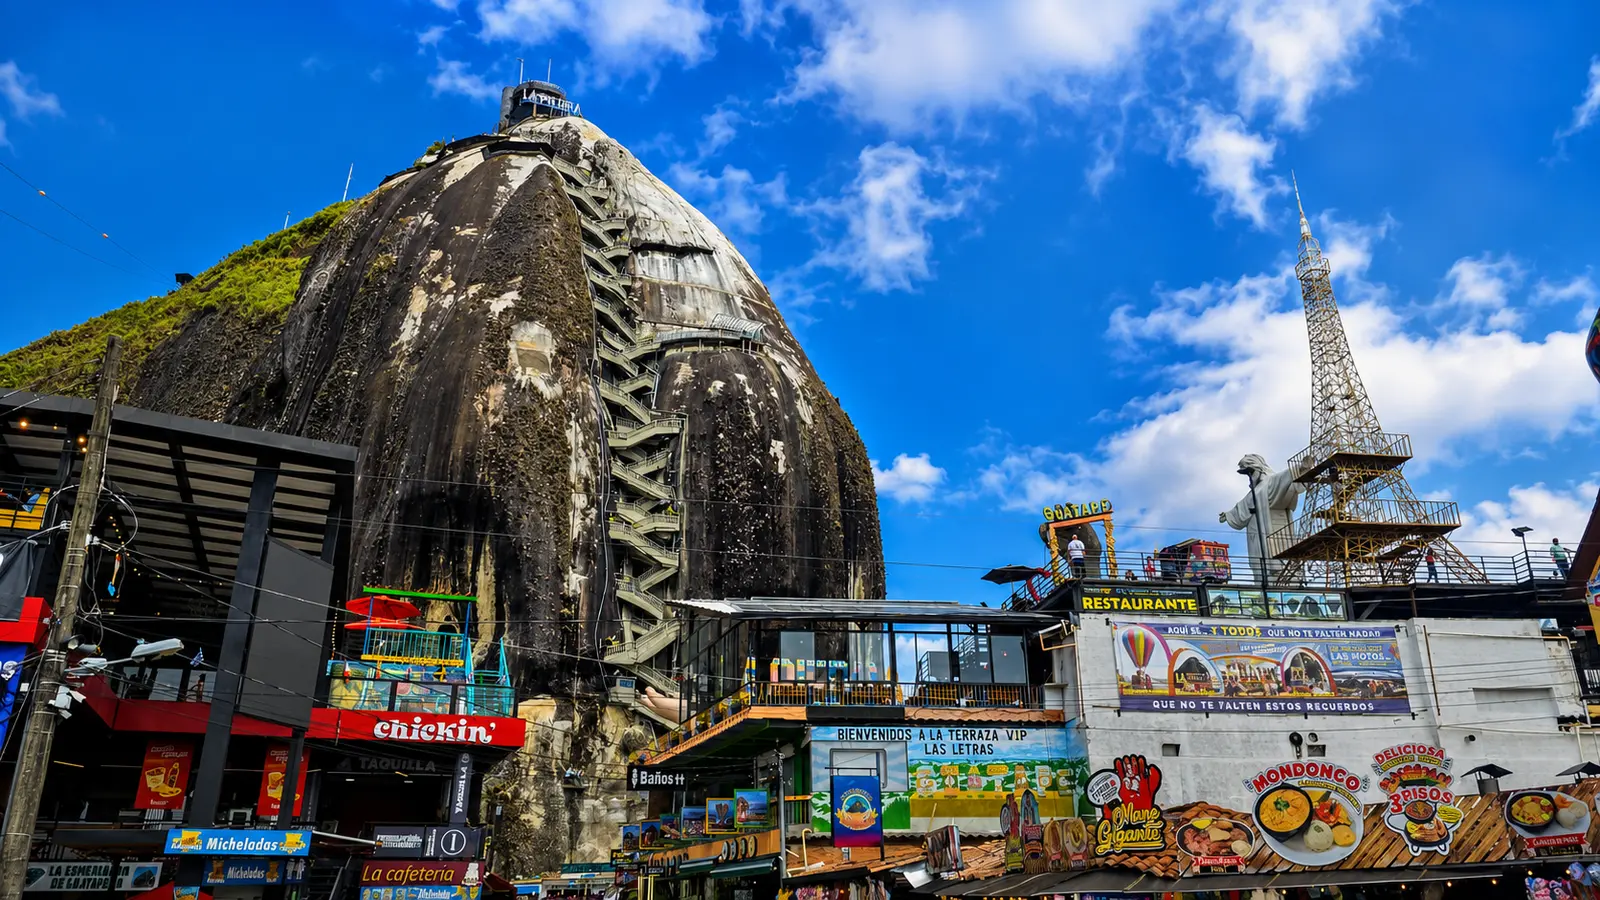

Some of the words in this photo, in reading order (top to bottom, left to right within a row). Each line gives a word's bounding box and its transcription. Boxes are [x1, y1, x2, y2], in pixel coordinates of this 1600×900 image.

[1082, 597, 1197, 611] RESTAURANTE
[1267, 629, 1285, 637] QUE
[1288, 629, 1301, 637] NO
[1303, 630, 1313, 638] TE
[1152, 700, 1176, 709] QUE
[1180, 701, 1196, 709] NO
[1200, 701, 1214, 710] TE
[1265, 702, 1301, 711] ESTOS
[1306, 702, 1374, 711] RECUERDOS
[837, 728, 912, 741] BIENVENIDOS
[918, 729, 926, 741] A
[929, 729, 943, 741] LA
[949, 729, 999, 741] TERRAZA
[1006, 730, 1027, 741] VIP
[924, 743, 946, 755] LAS
[952, 743, 994, 755] LETRAS
[1375, 745, 1445, 764] DELICIOSA
[359, 757, 436, 773] TAQUILLA
[640, 771, 674, 785] Baños
[1390, 793, 1403, 813] 3
[1401, 788, 1453, 803] PISOS
[206, 838, 278, 851] Micheladas
[1096, 820, 1163, 855] Gigante
[49, 866, 61, 876] LA
[227, 866, 265, 880] Micheladas
[362, 865, 383, 881] La
[386, 864, 455, 886] cafetería
[50, 878, 64, 889] DE
